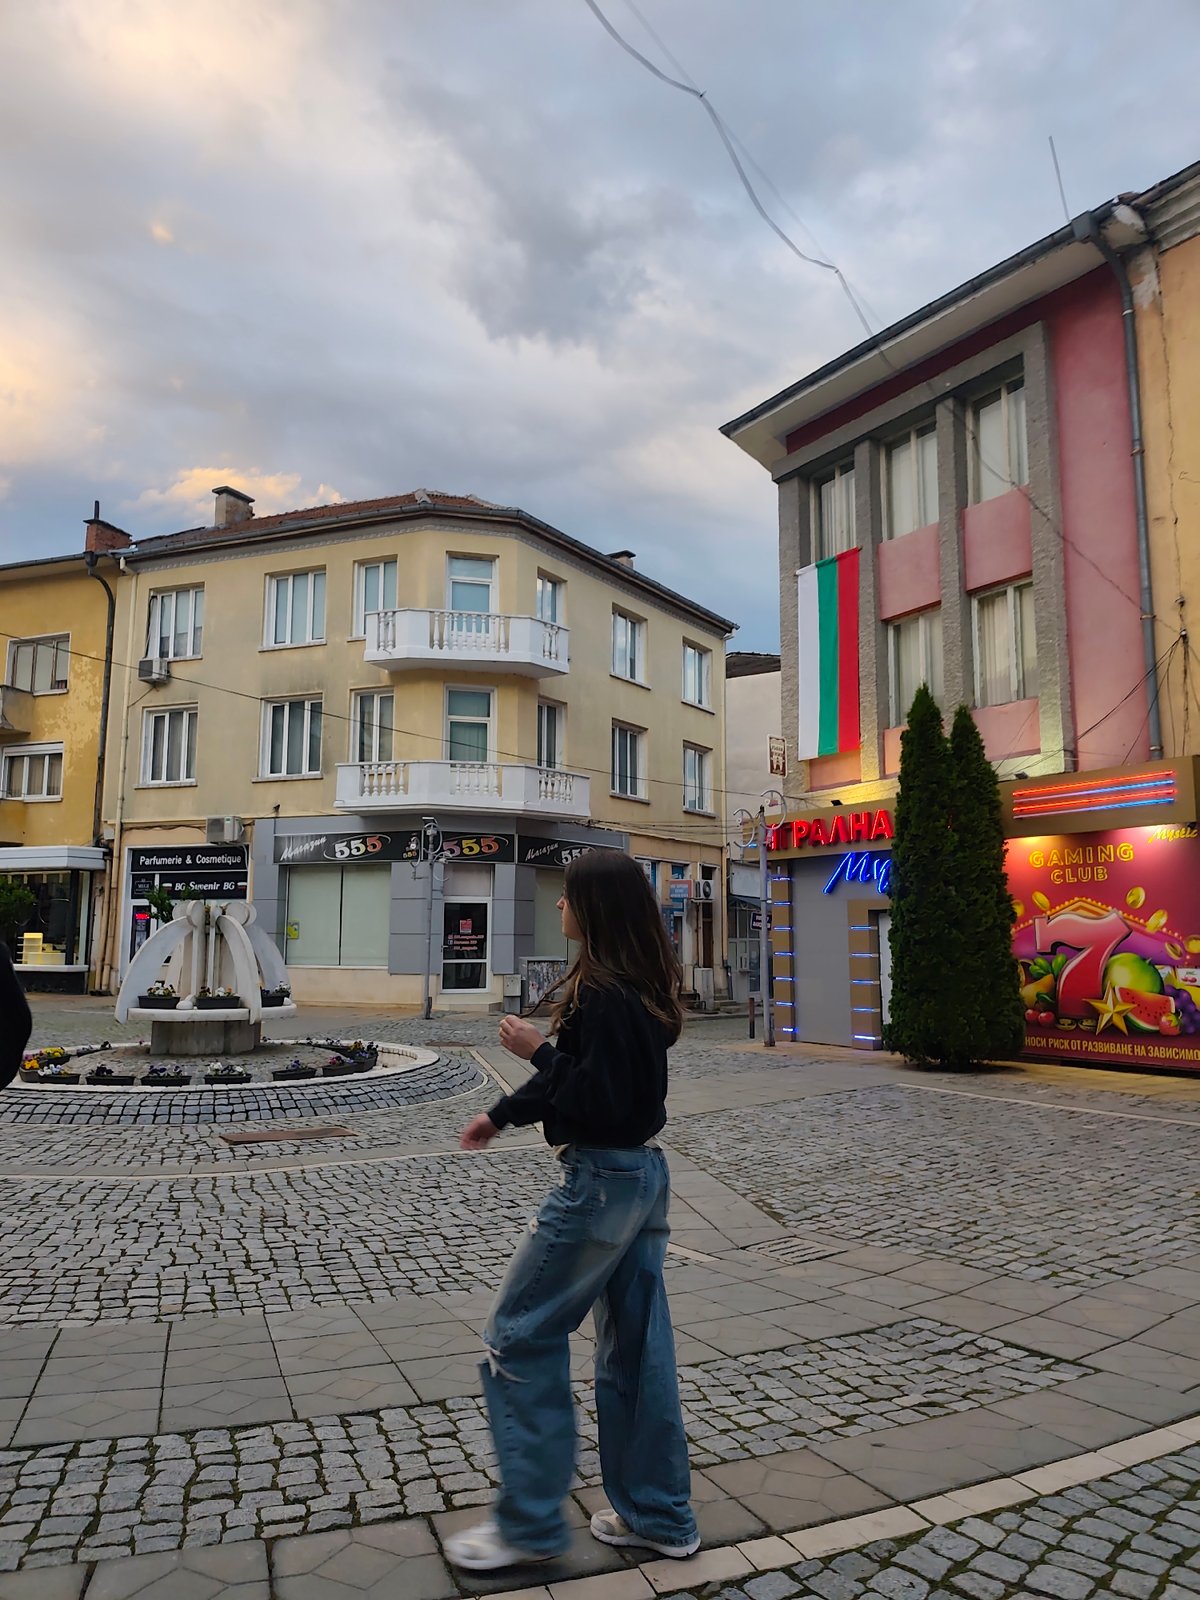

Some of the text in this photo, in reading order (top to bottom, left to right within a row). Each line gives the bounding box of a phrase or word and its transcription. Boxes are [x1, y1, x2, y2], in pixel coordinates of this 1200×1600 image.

[1148, 827, 1198, 843] Mystic
[334, 836, 383, 859] 555
[443, 837, 500, 858] 555
[1029, 842, 1134, 868] GAMING
[140, 853, 242, 866] Parfumerie & Cosmetique
[1050, 866, 1109, 885] CLUB
[174, 881, 235, 891] BG Suvenir BG
[1033, 909, 1133, 1020] 7
[1025, 1036, 1047, 1048] НОСИ
[1048, 1038, 1071, 1050] РИСК
[1071, 1040, 1081, 1051] ОТ
[1082, 1040, 1133, 1056] РАЗВИВАНЕ
[1134, 1044, 1147, 1056] НА
